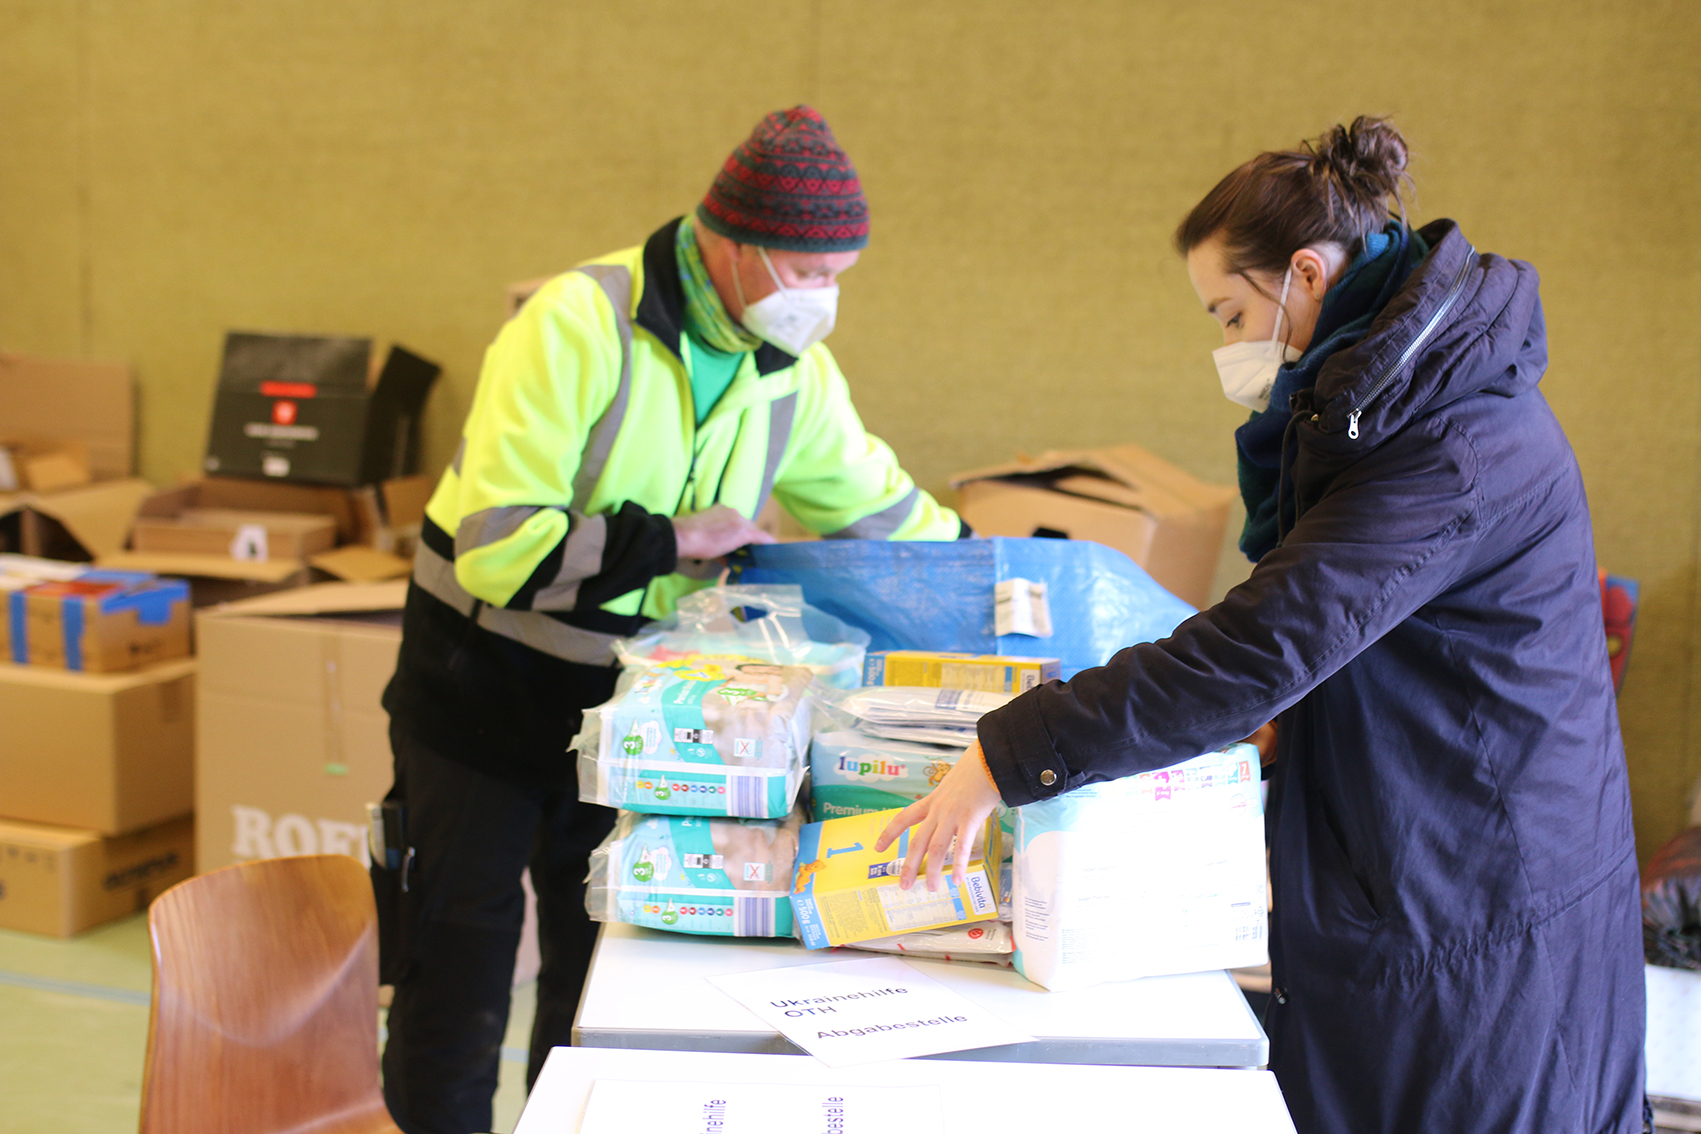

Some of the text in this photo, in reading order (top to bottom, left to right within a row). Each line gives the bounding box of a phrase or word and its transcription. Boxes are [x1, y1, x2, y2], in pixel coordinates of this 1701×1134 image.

[624, 741, 636, 750] 3
[838, 756, 901, 777] lupilu
[826, 842, 864, 859] 1
[633, 867, 646, 876] 3
[971, 876, 987, 909] Bebivita
[798, 906, 810, 920] 500
[770, 987, 909, 1009] Ukrainehilfe
[784, 1005, 838, 1018] OTH
[816, 1014, 968, 1039] Abgabestelle
